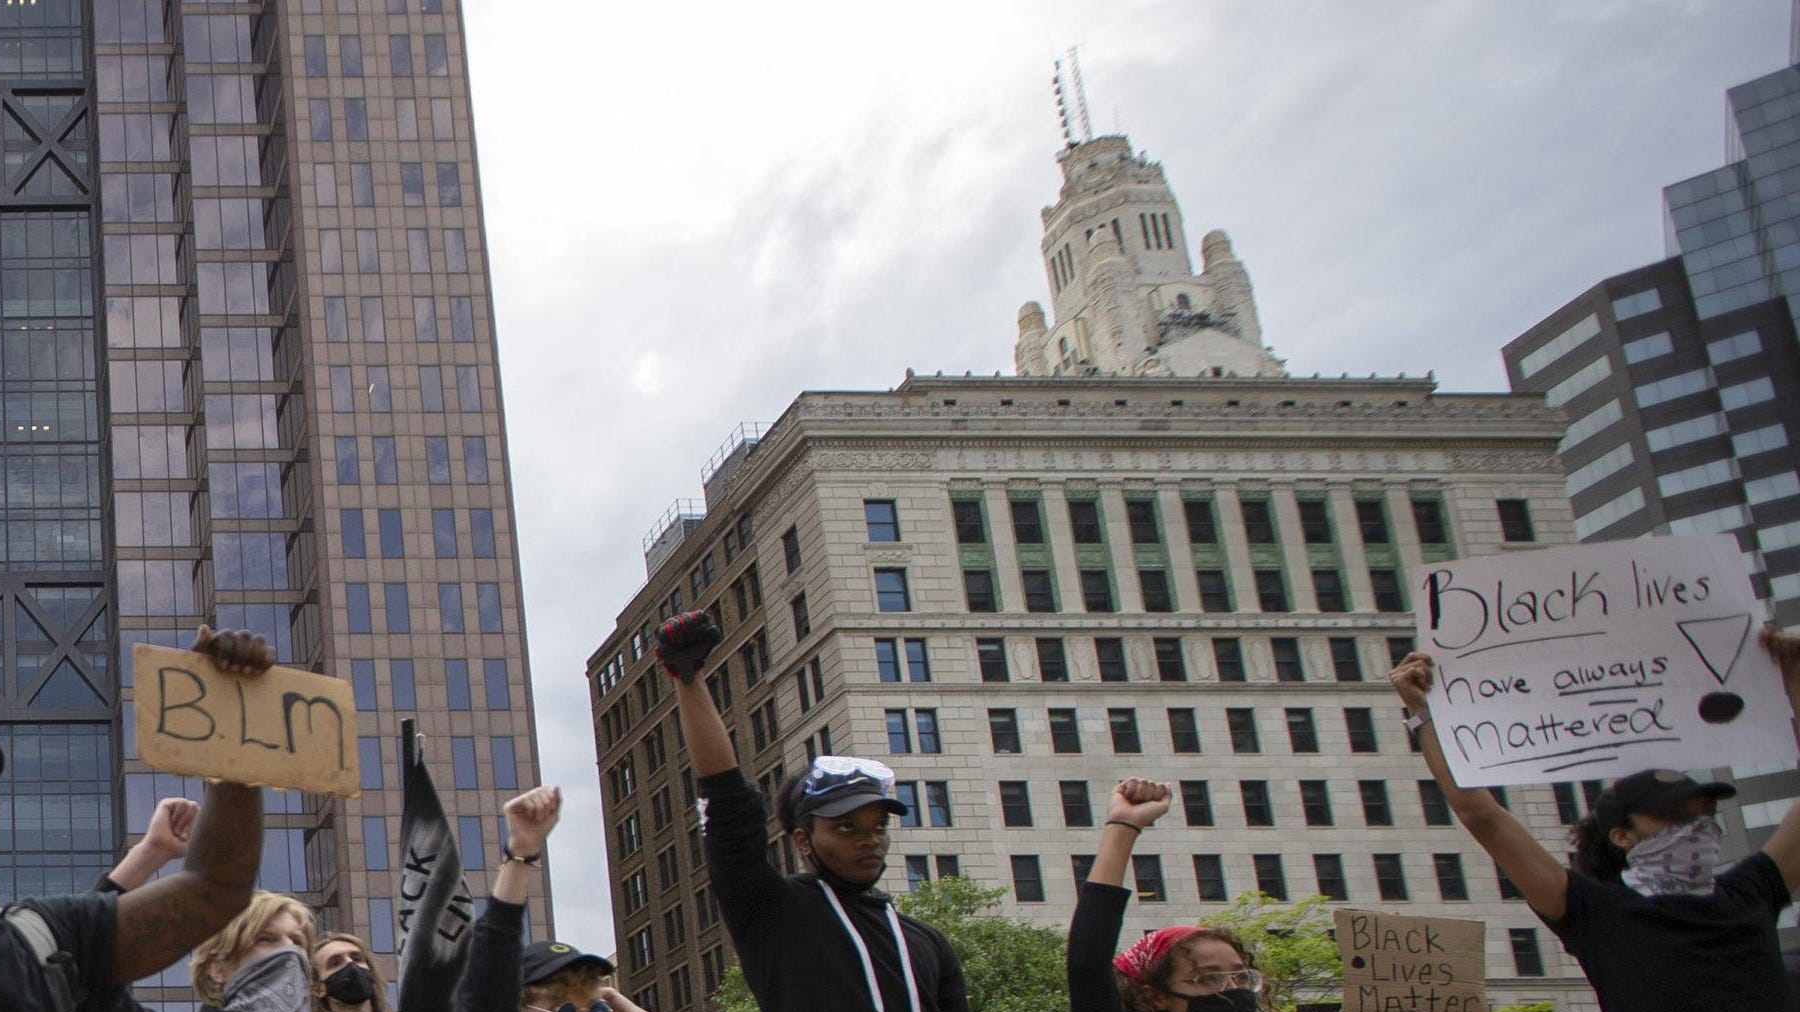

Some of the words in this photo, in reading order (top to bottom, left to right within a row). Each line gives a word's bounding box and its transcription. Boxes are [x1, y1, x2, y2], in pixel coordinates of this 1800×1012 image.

[1422, 569, 1608, 650] Black
[1631, 559, 1710, 609] lives
[1437, 666, 1532, 705] have
[1553, 656, 1669, 688] always
[1371, 953, 1454, 986] Lives
